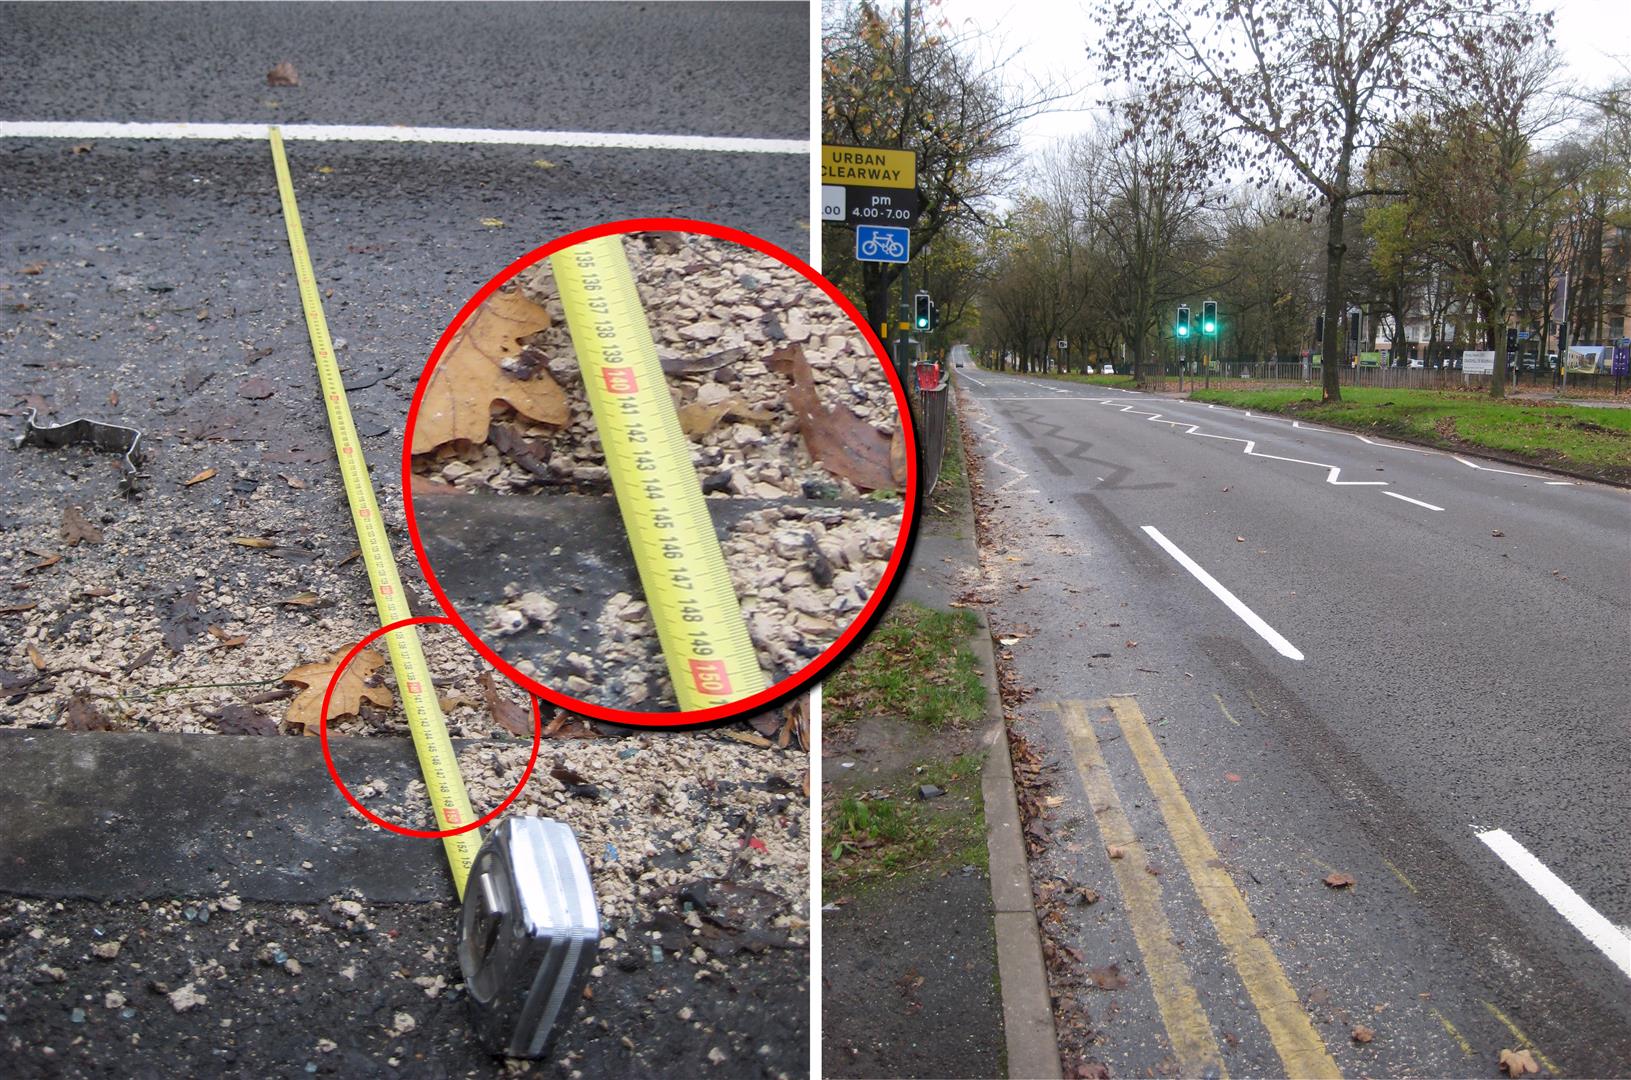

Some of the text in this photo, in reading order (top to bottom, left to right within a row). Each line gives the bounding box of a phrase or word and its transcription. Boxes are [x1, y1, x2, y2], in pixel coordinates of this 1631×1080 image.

[833, 152, 885, 165] URBAN
[872, 196, 891, 206] pm
[574, 250, 722, 690] 135 136 137 138 139 140 141 142 143 144 145 146 147 148 149 150
[456, 841, 469, 853] 152
